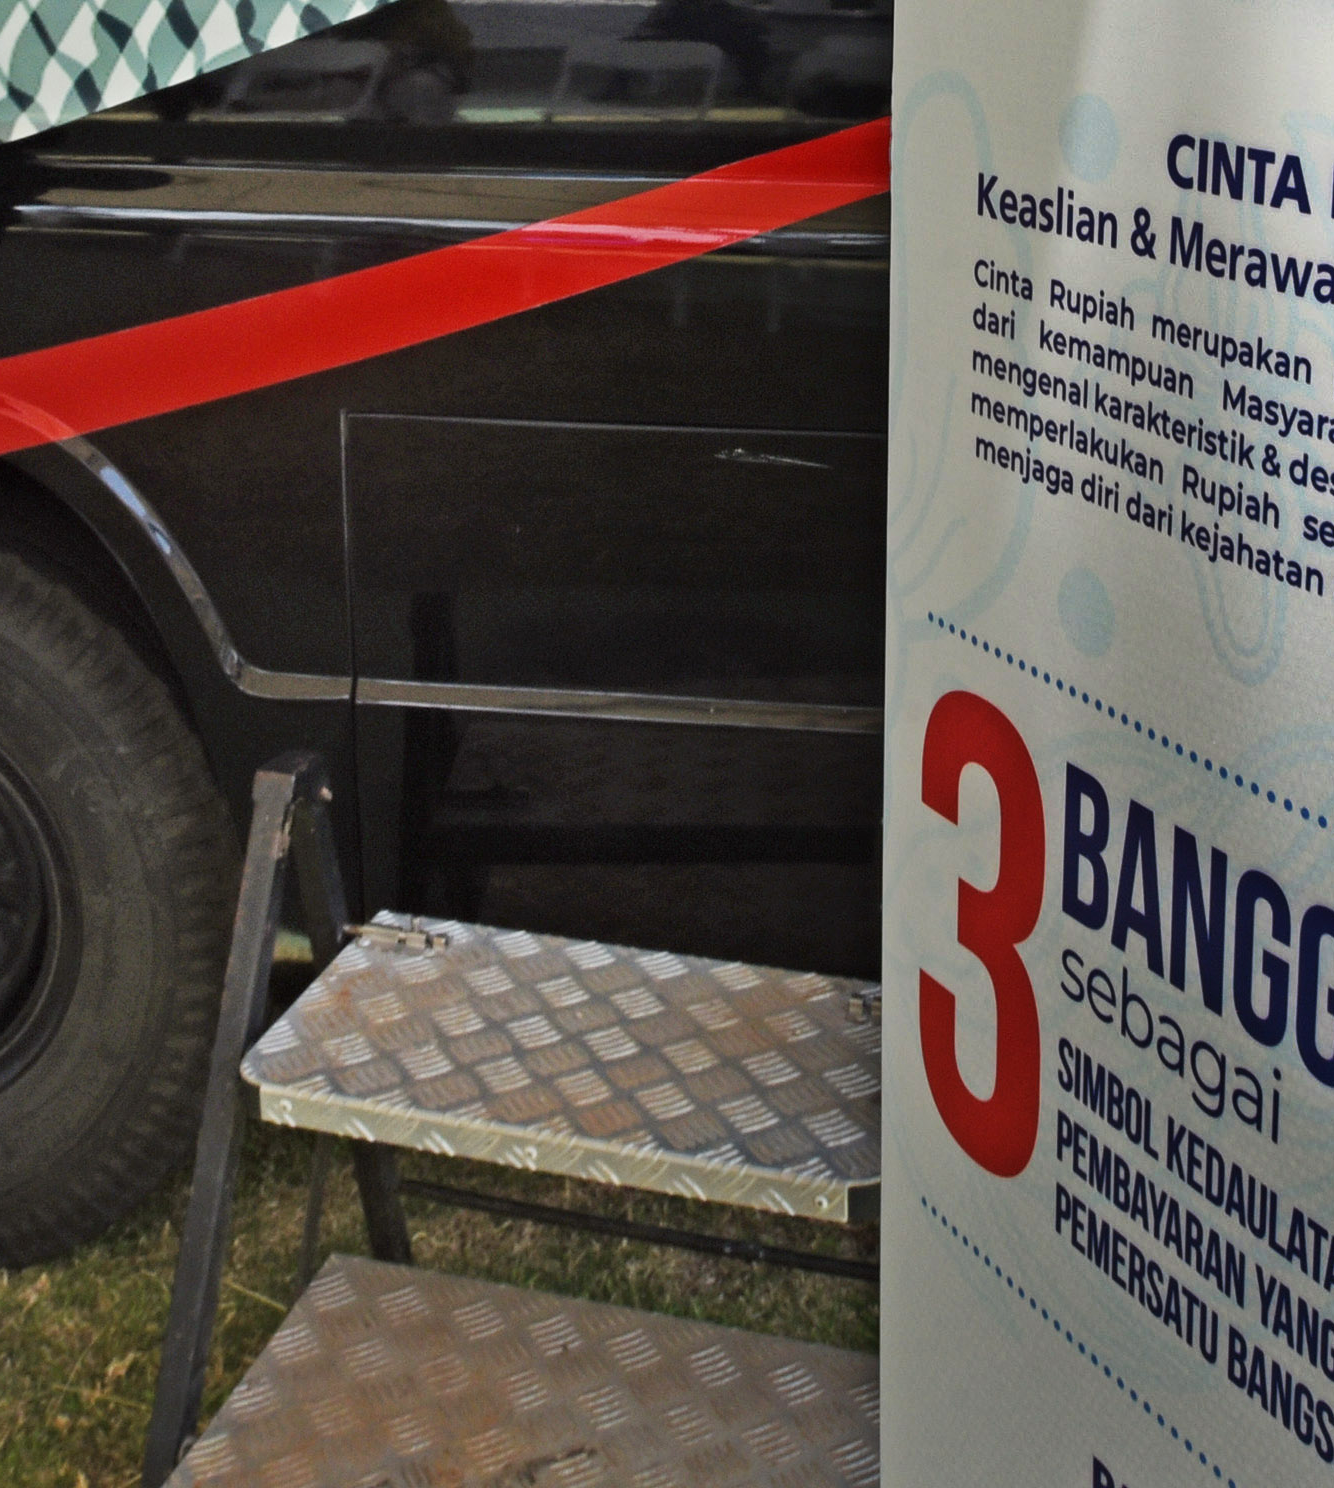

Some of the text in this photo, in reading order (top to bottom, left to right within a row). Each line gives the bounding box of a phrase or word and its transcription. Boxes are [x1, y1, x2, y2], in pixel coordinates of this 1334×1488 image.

[978, 172, 1117, 248] Keaslian
[1131, 207, 1156, 259] &
[1167, 134, 1311, 214] CINTA
[973, 302, 1015, 340] dari
[1038, 315, 1193, 401] kemampuan
[974, 259, 1033, 301] Cinta
[1050, 279, 1134, 331] Rupiah
[1148, 315, 1311, 388] merupakan
[972, 392, 1163, 485] memperlakukan
[1183, 464, 1279, 531] Rupiah
[973, 350, 1088, 409] mengenal
[1090, 379, 1255, 473] karakteristik
[1262, 444, 1280, 478] &
[976, 437, 1073, 495] menjaga
[1081, 473, 1119, 513] diri
[1126, 491, 1173, 536] dari
[1180, 518, 1323, 596] kejahatan
[919, 689, 1046, 1179] 3
[1058, 949, 1281, 1145] sebagai
[1058, 1038, 1159, 1161] SIMBOL
[1054, 1180, 1218, 1365] PEMERSATU
[1055, 1110, 1246, 1309] PEMBAYARAN
